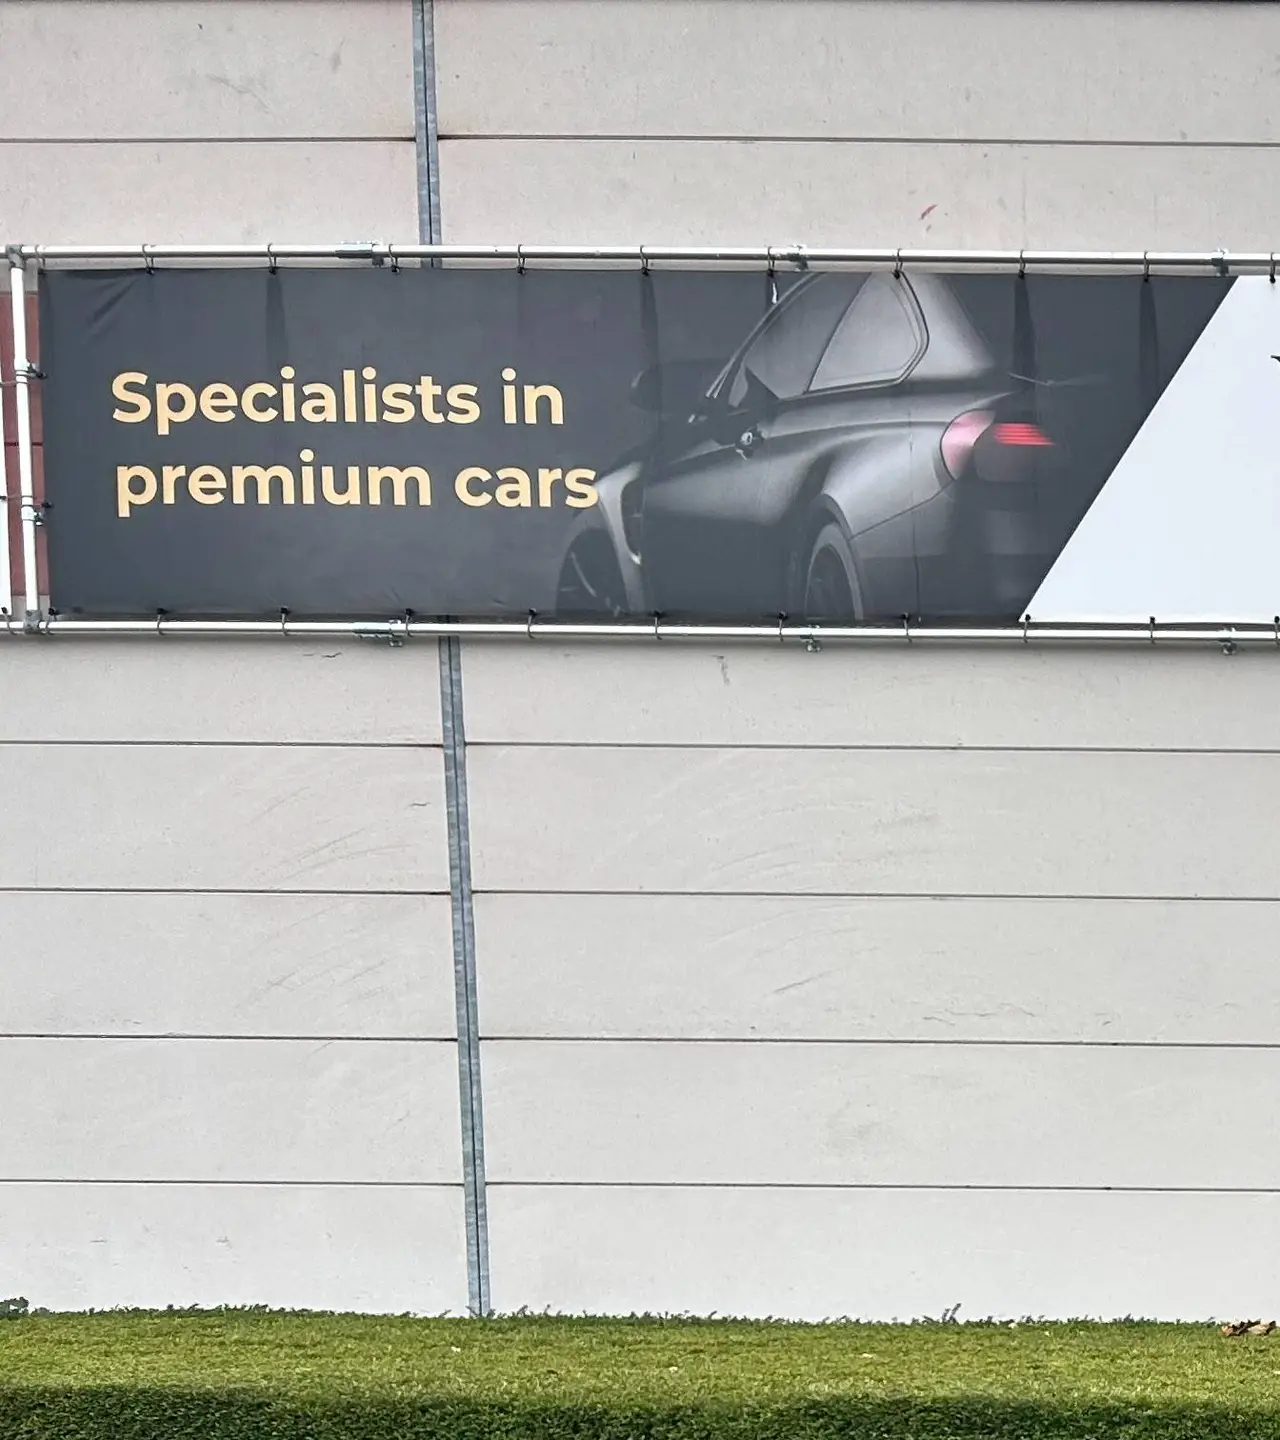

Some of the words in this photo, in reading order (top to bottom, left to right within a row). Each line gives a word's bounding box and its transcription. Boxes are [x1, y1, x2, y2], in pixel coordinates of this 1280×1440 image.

[111, 366, 480, 435] Specialists
[503, 367, 565, 425] in
[117, 448, 432, 518] premium
[455, 465, 599, 509] cars
